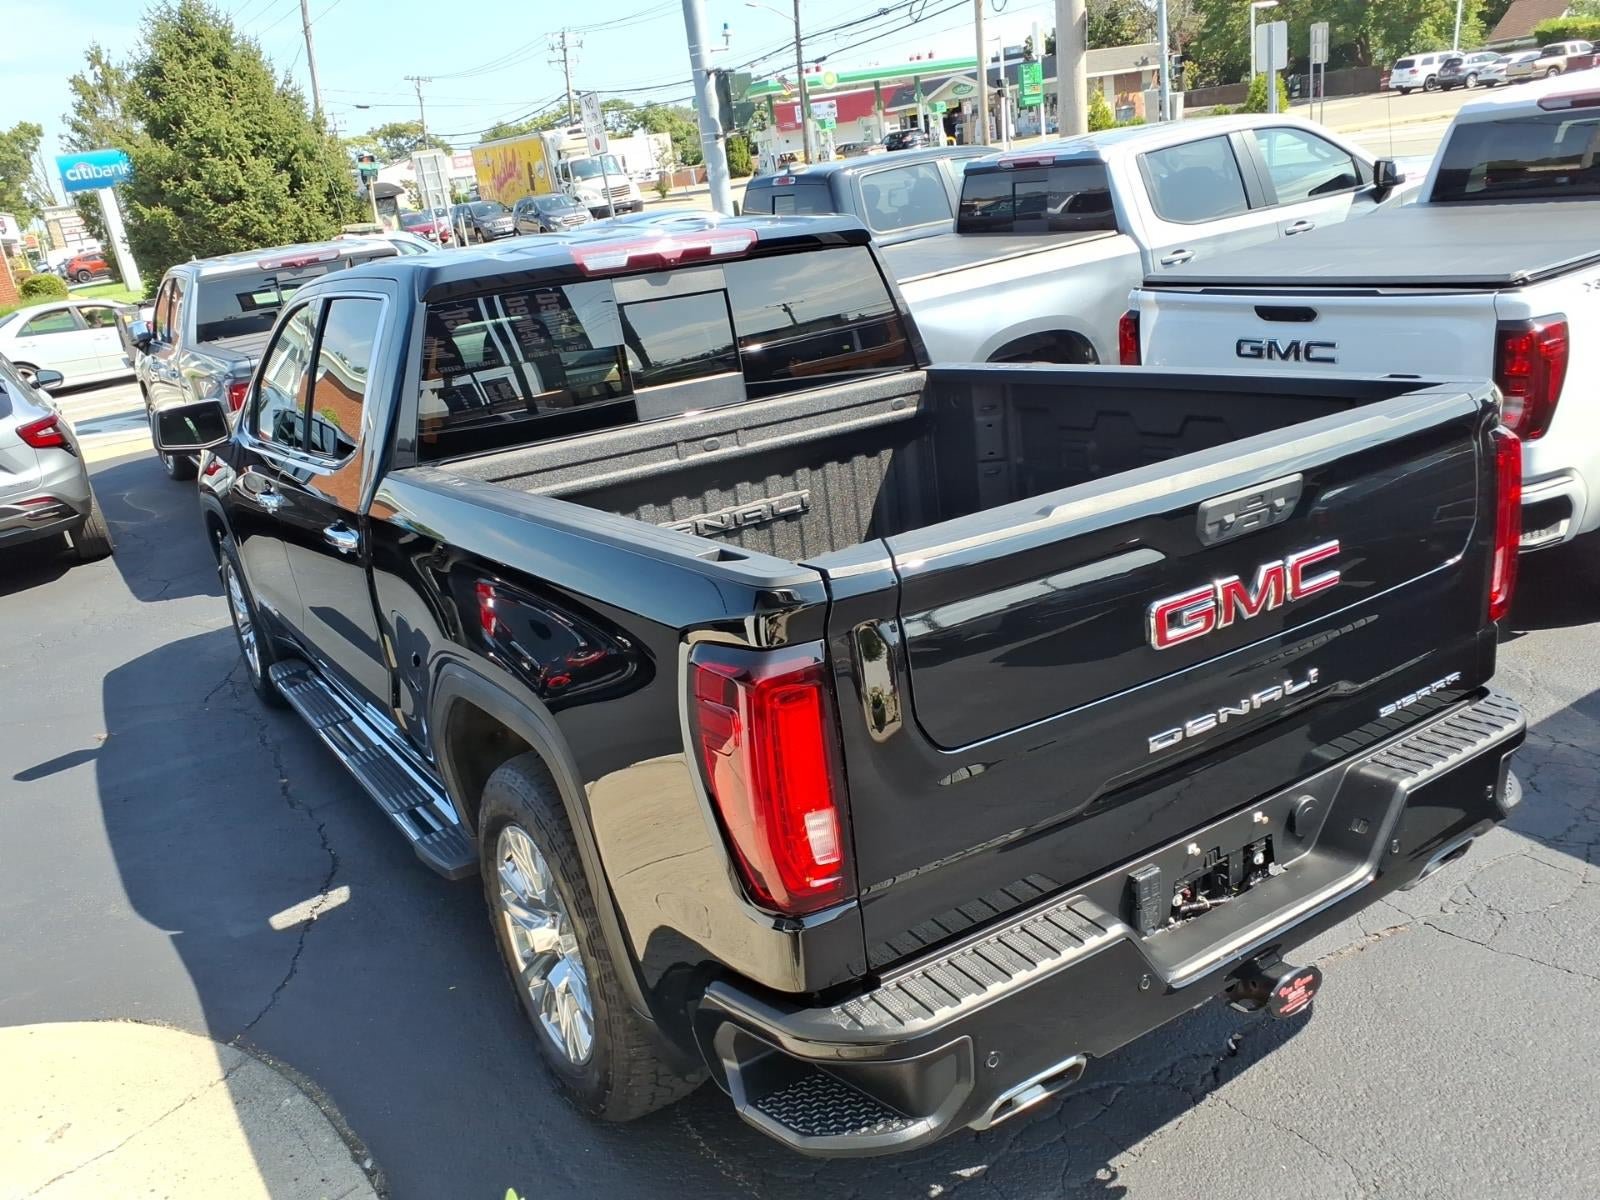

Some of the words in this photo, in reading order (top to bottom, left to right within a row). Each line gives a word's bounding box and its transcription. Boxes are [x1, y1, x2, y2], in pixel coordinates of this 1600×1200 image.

[65, 161, 131, 182] citibank
[1235, 338, 1337, 364] GMC
[1147, 539, 1341, 650] GMC
[1148, 667, 1320, 754] DENALI
[1378, 671, 1462, 718] SIERRA
